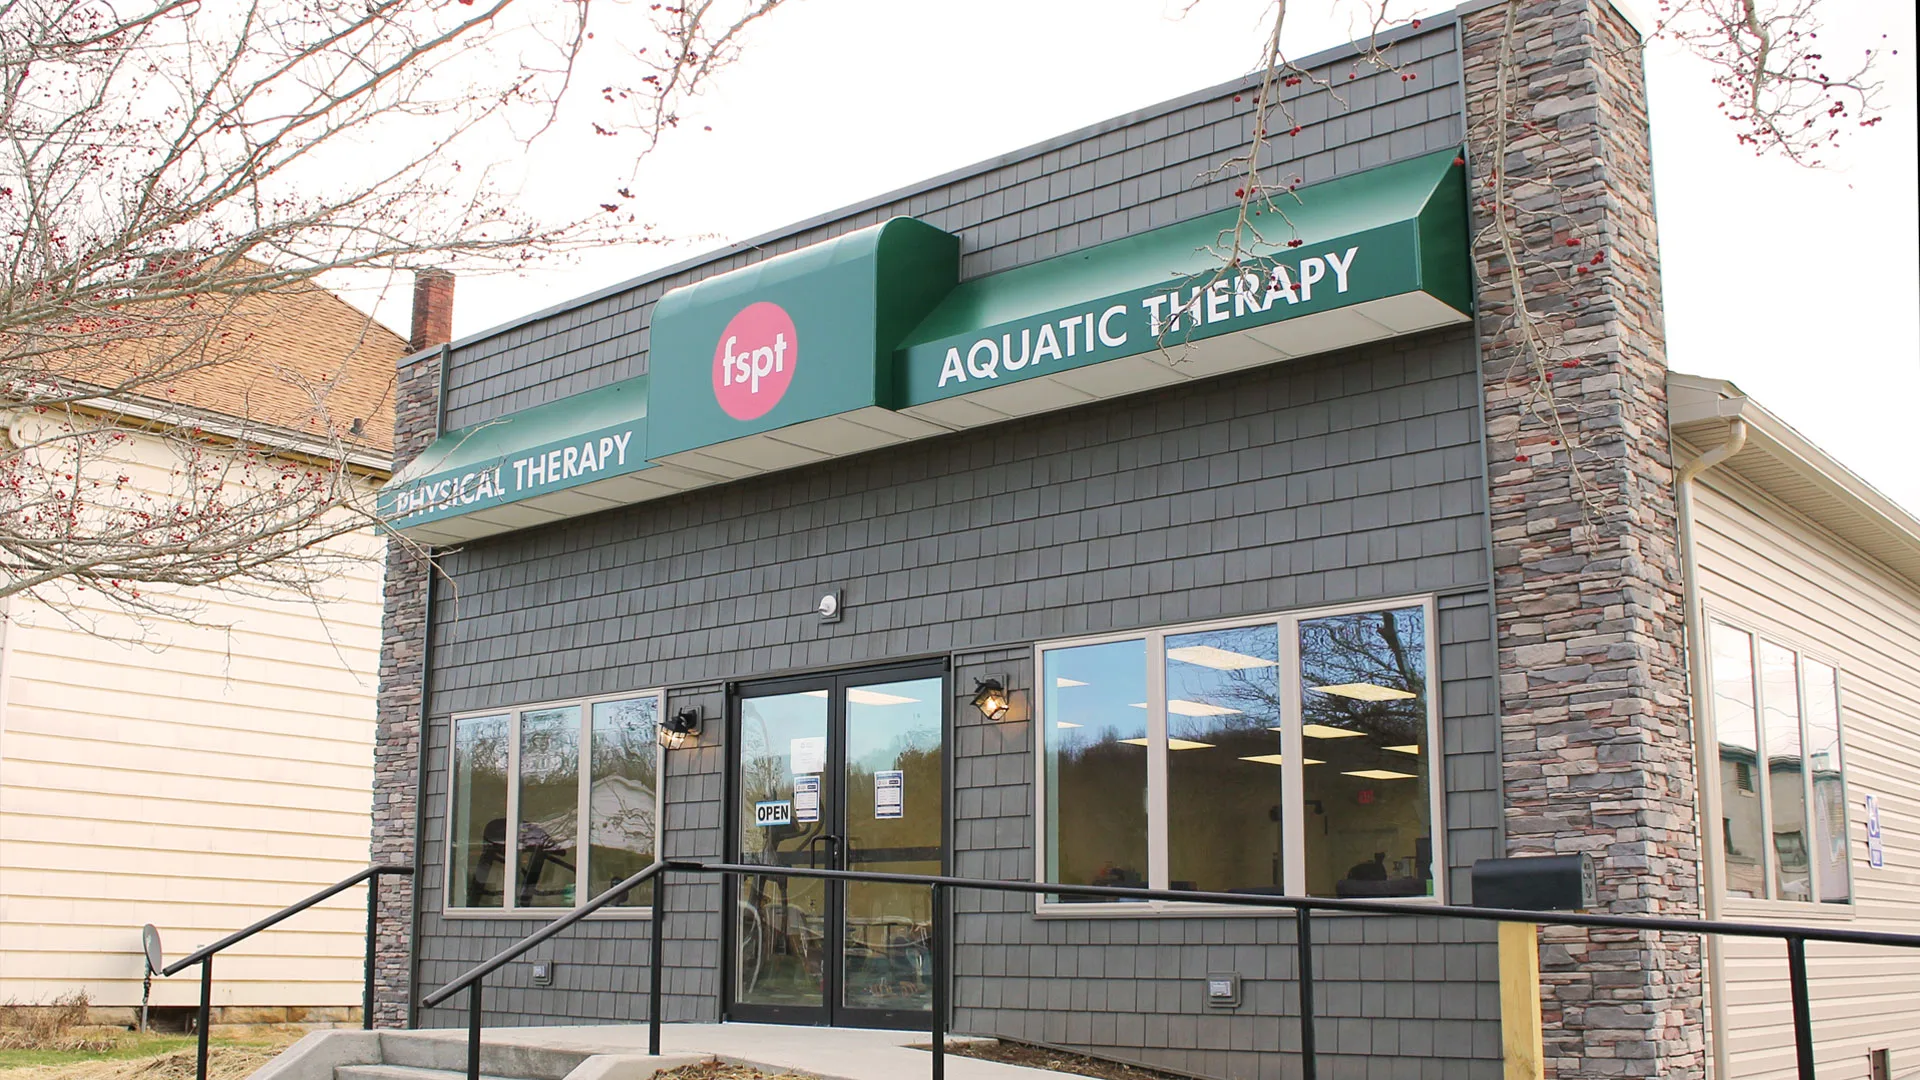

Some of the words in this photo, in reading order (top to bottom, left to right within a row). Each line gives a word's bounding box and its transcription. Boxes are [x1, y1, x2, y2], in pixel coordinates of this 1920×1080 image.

[937, 305, 1128, 388] AQUATIC
[1142, 246, 1359, 338] THERAPY
[723, 333, 787, 394] fspt
[396, 467, 506, 519] PHYSICAL
[512, 431, 633, 491] THERAPY
[757, 804, 789, 821] OPEN
